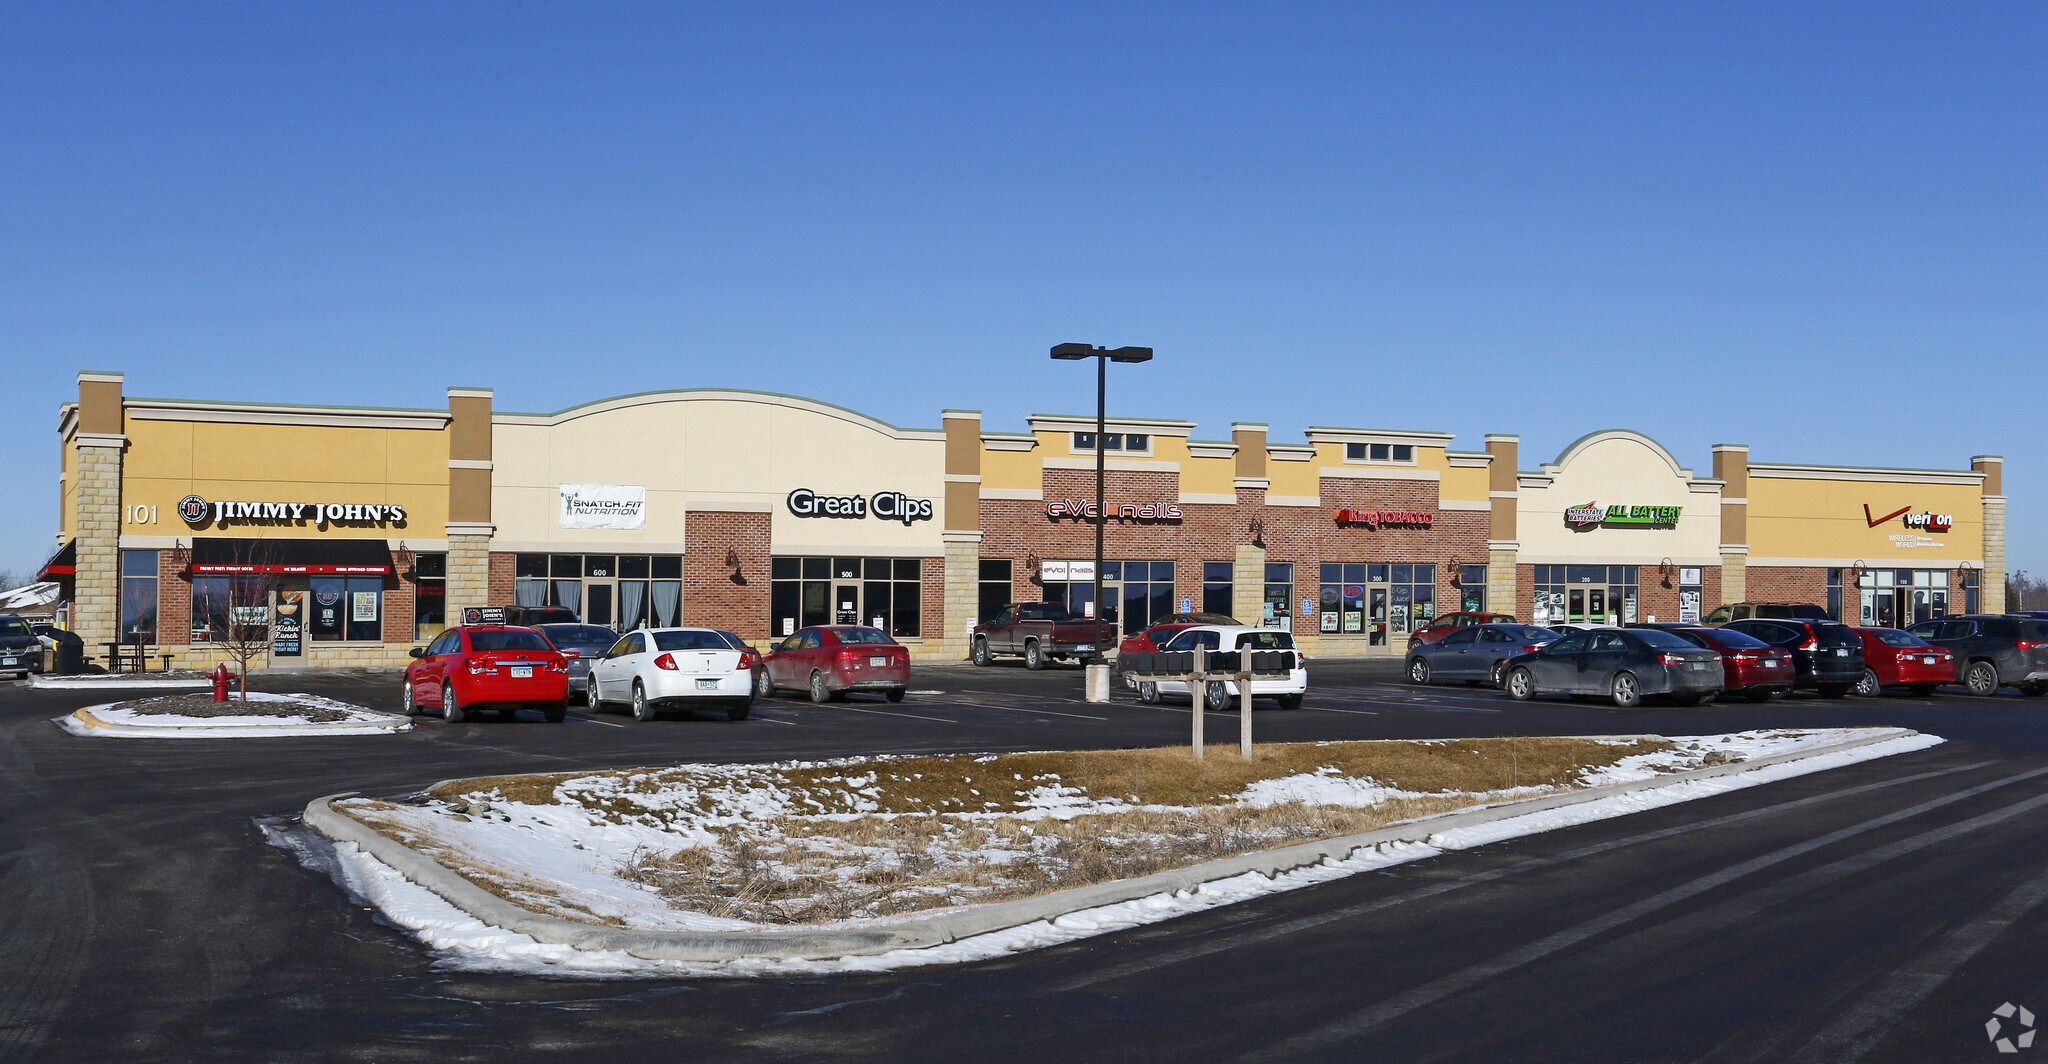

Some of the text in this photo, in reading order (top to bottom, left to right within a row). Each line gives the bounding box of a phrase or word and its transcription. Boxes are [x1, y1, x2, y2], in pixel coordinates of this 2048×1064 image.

[573, 500, 644, 508] SNATCH.FIT
[788, 489, 932, 522] Great Clips
[1119, 502, 1183, 518] nails
[1608, 505, 1683, 517] ALL BATTERY
[126, 504, 158, 524] 101
[213, 501, 403, 524] JIMMY JOHN'S
[1348, 509, 1434, 525] King TOBACCO
[1907, 511, 1952, 528] verizon
[593, 569, 607, 577] 600
